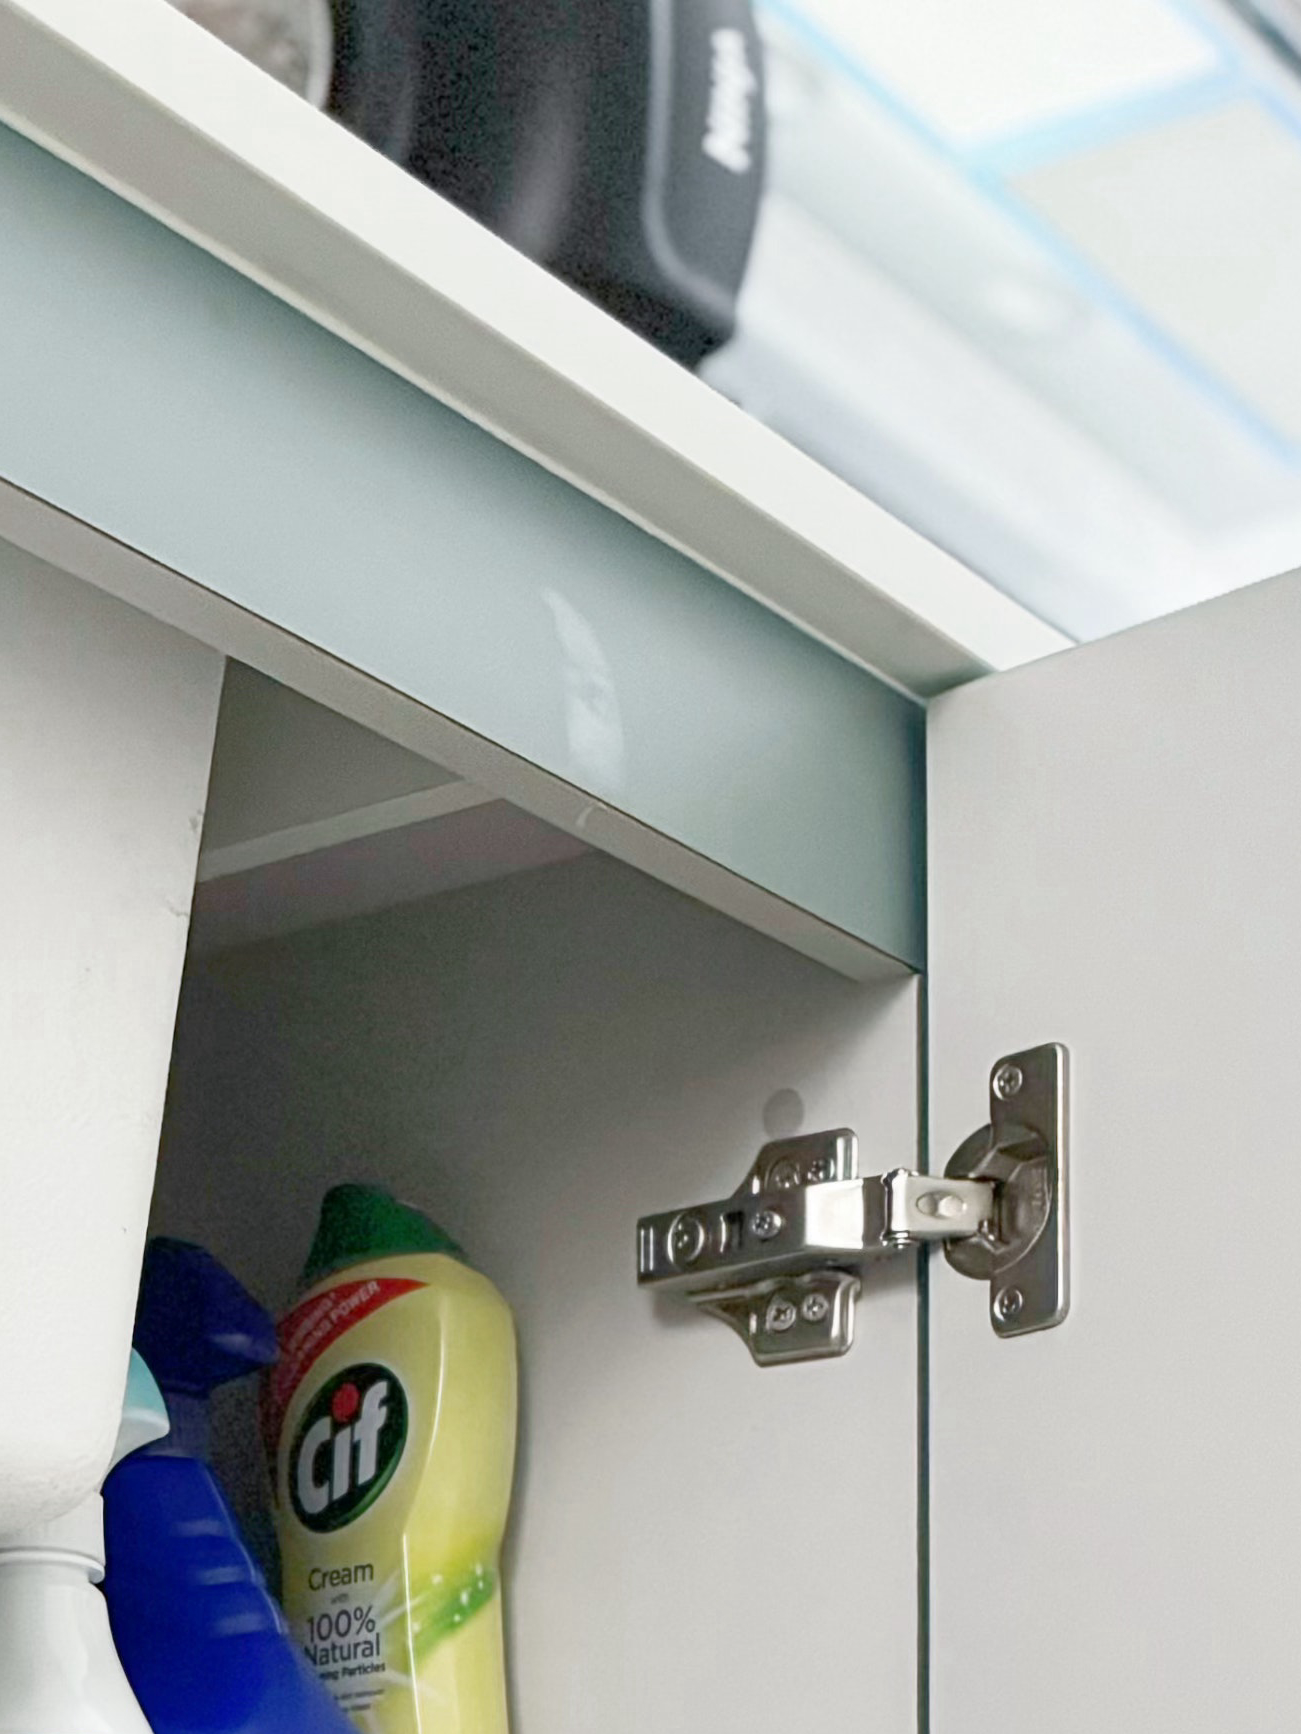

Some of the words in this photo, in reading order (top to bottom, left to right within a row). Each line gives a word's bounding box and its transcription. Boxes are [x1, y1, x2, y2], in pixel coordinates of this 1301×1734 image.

[330, 1280, 381, 1325] POWER
[297, 1380, 388, 1514] Cif
[308, 1563, 374, 1592] Cream
[306, 1605, 377, 1644] 100%
[303, 1632, 381, 1667] Natural
[341, 1661, 387, 1678] Particles
